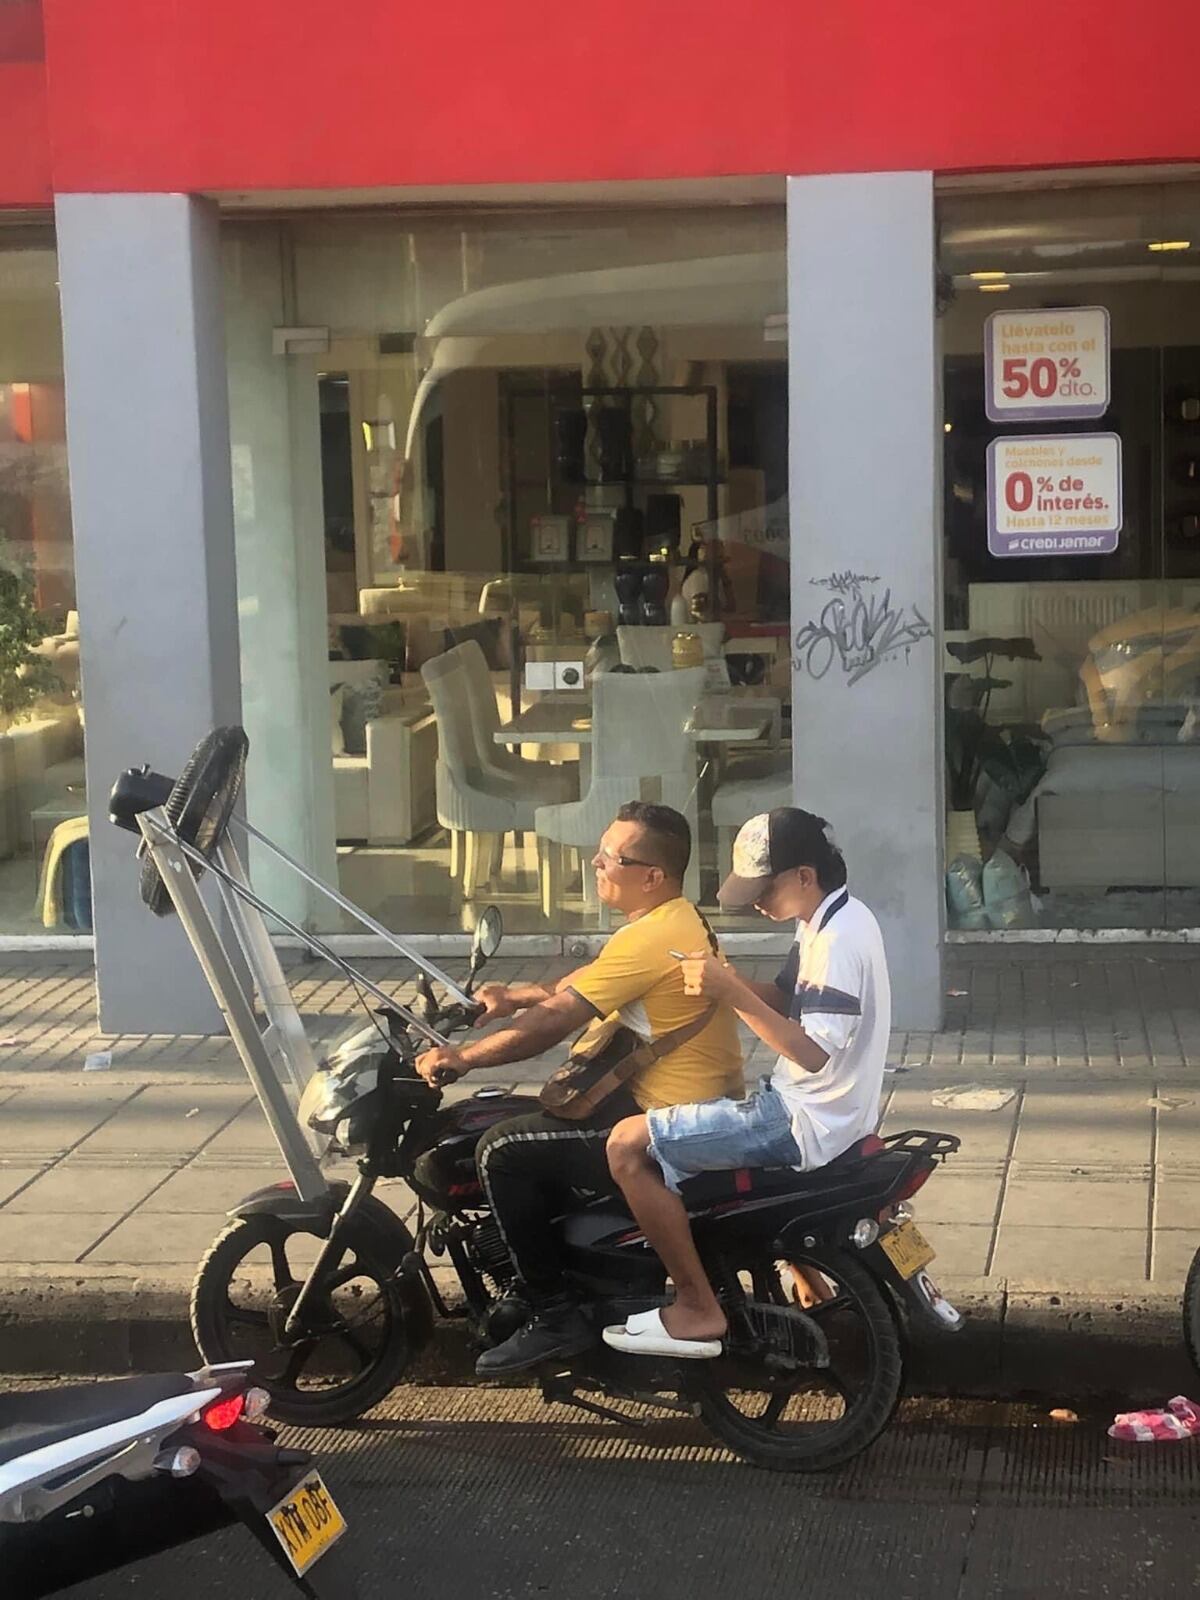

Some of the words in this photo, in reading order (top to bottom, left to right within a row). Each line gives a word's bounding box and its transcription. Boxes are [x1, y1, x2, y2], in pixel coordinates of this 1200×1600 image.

[1001, 340, 1044, 354] hasta
[1048, 340, 1077, 353] con
[1082, 338, 1096, 352] el
[1059, 380, 1097, 397] dto.
[1058, 447, 1065, 457] y
[1067, 455, 1103, 466] desde
[1059, 475, 1084, 492] de
[1037, 493, 1109, 512] interés.
[1006, 514, 1046, 528] Hasta
[1049, 515, 1062, 526] 12
[1065, 514, 1110, 526] meses
